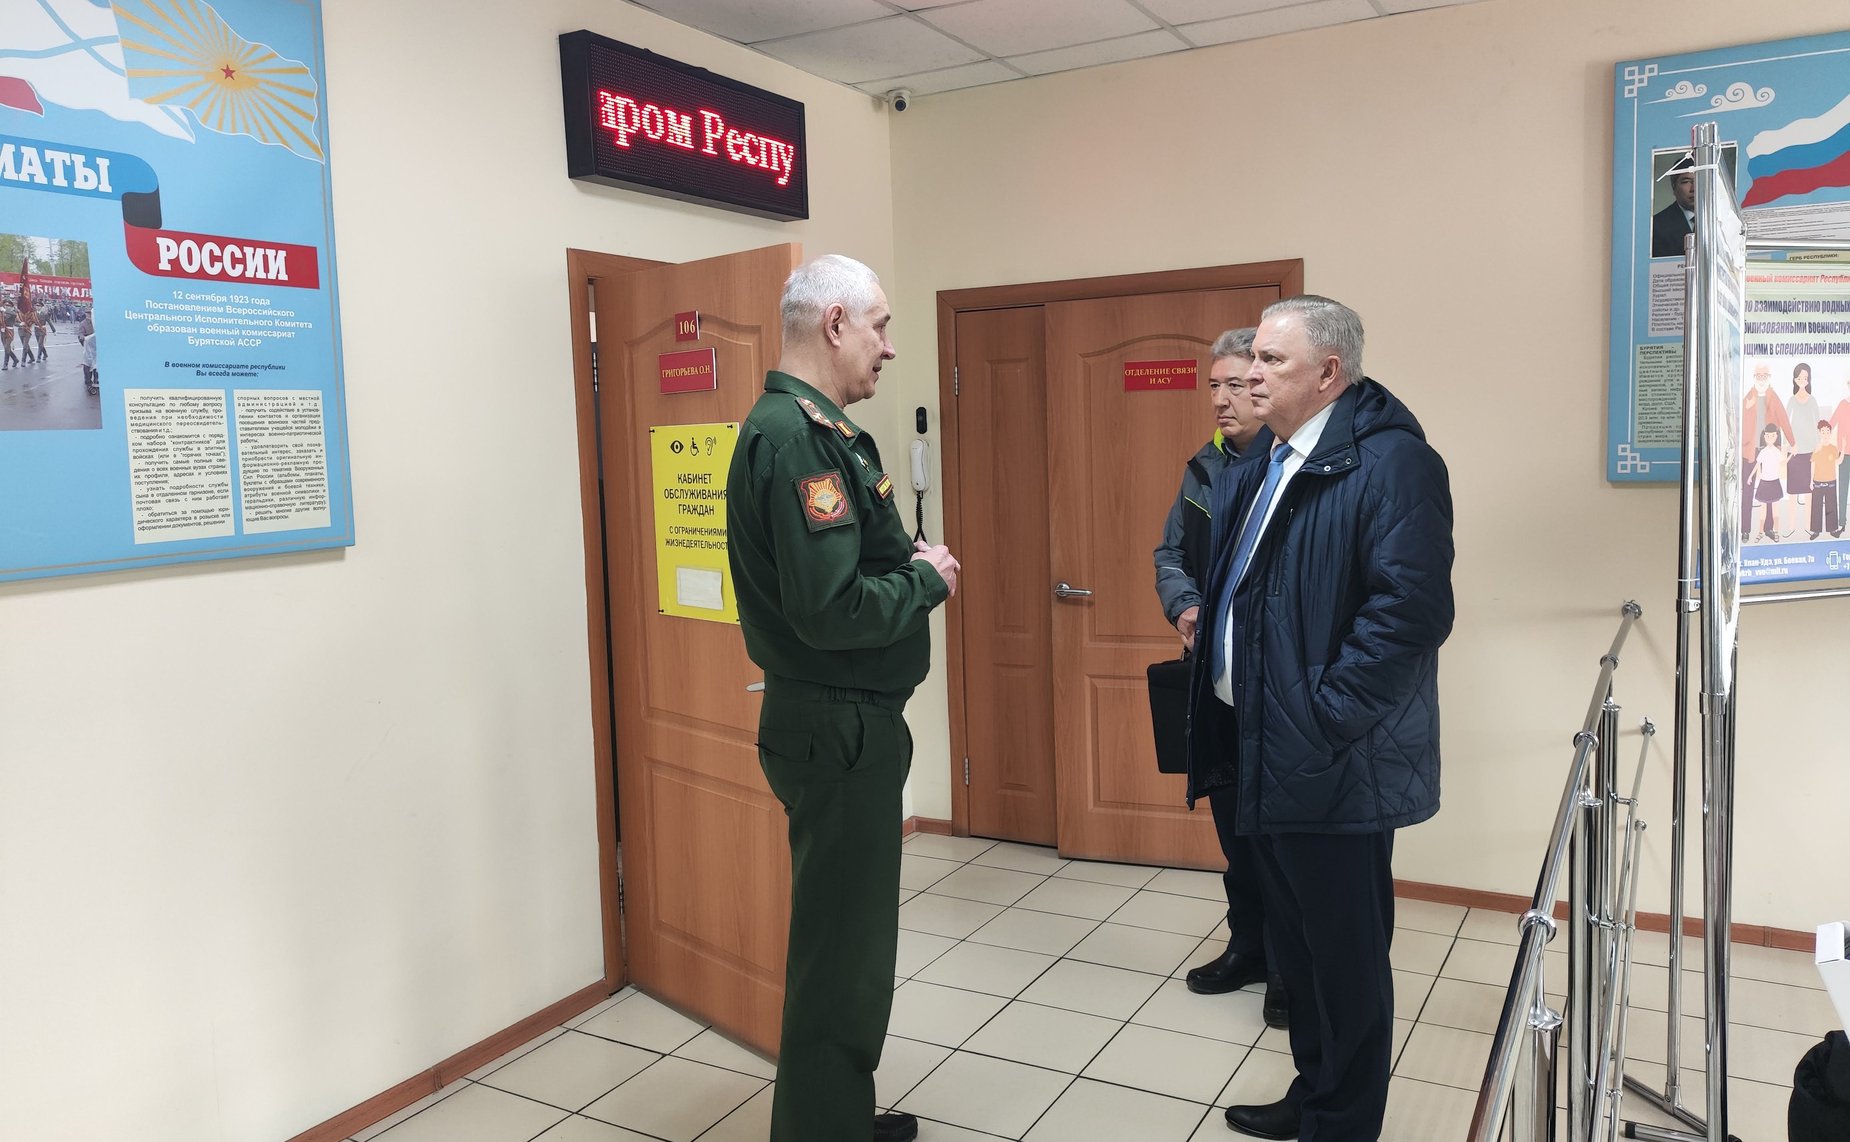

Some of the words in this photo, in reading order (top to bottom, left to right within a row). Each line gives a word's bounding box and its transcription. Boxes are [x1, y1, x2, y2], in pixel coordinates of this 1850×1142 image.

[700, 109, 795, 185] Респу
[156, 237, 288, 280] РОССИИ
[173, 291, 183, 299] 12
[186, 294, 227, 304] сентября
[230, 295, 249, 304] 1923
[145, 300, 223, 314] Постановлением
[227, 308, 295, 318] Всероссийского
[1754, 298, 1820, 314] взаимодействию
[125, 311, 193, 323] Центрального
[195, 315, 273, 328] Исполнительного
[275, 320, 312, 329] Комитета
[147, 324, 197, 334] образован
[200, 327, 239, 336] военный
[242, 329, 295, 339] комиссариат
[680, 320, 695, 334] 106
[188, 336, 235, 347] Бурятской
[238, 338, 262, 347] АССР
[1770, 345, 1774, 355] в
[1775, 340, 1826, 357] специальной
[662, 367, 698, 378] ГРИГОРЬЕВА
[700, 365, 712, 374] О.Н.
[1125, 368, 1170, 376] ОТДЕЛЕНИЕ
[678, 474, 712, 484] КАБИНЕТ
[664, 489, 727, 500] ОБСЛУЖИВАНИЯ
[678, 504, 715, 517] ГРАЖДАН
[669, 526, 673, 534] С
[674, 526, 727, 537] ОГРАНИЧЕНИЯМИ
